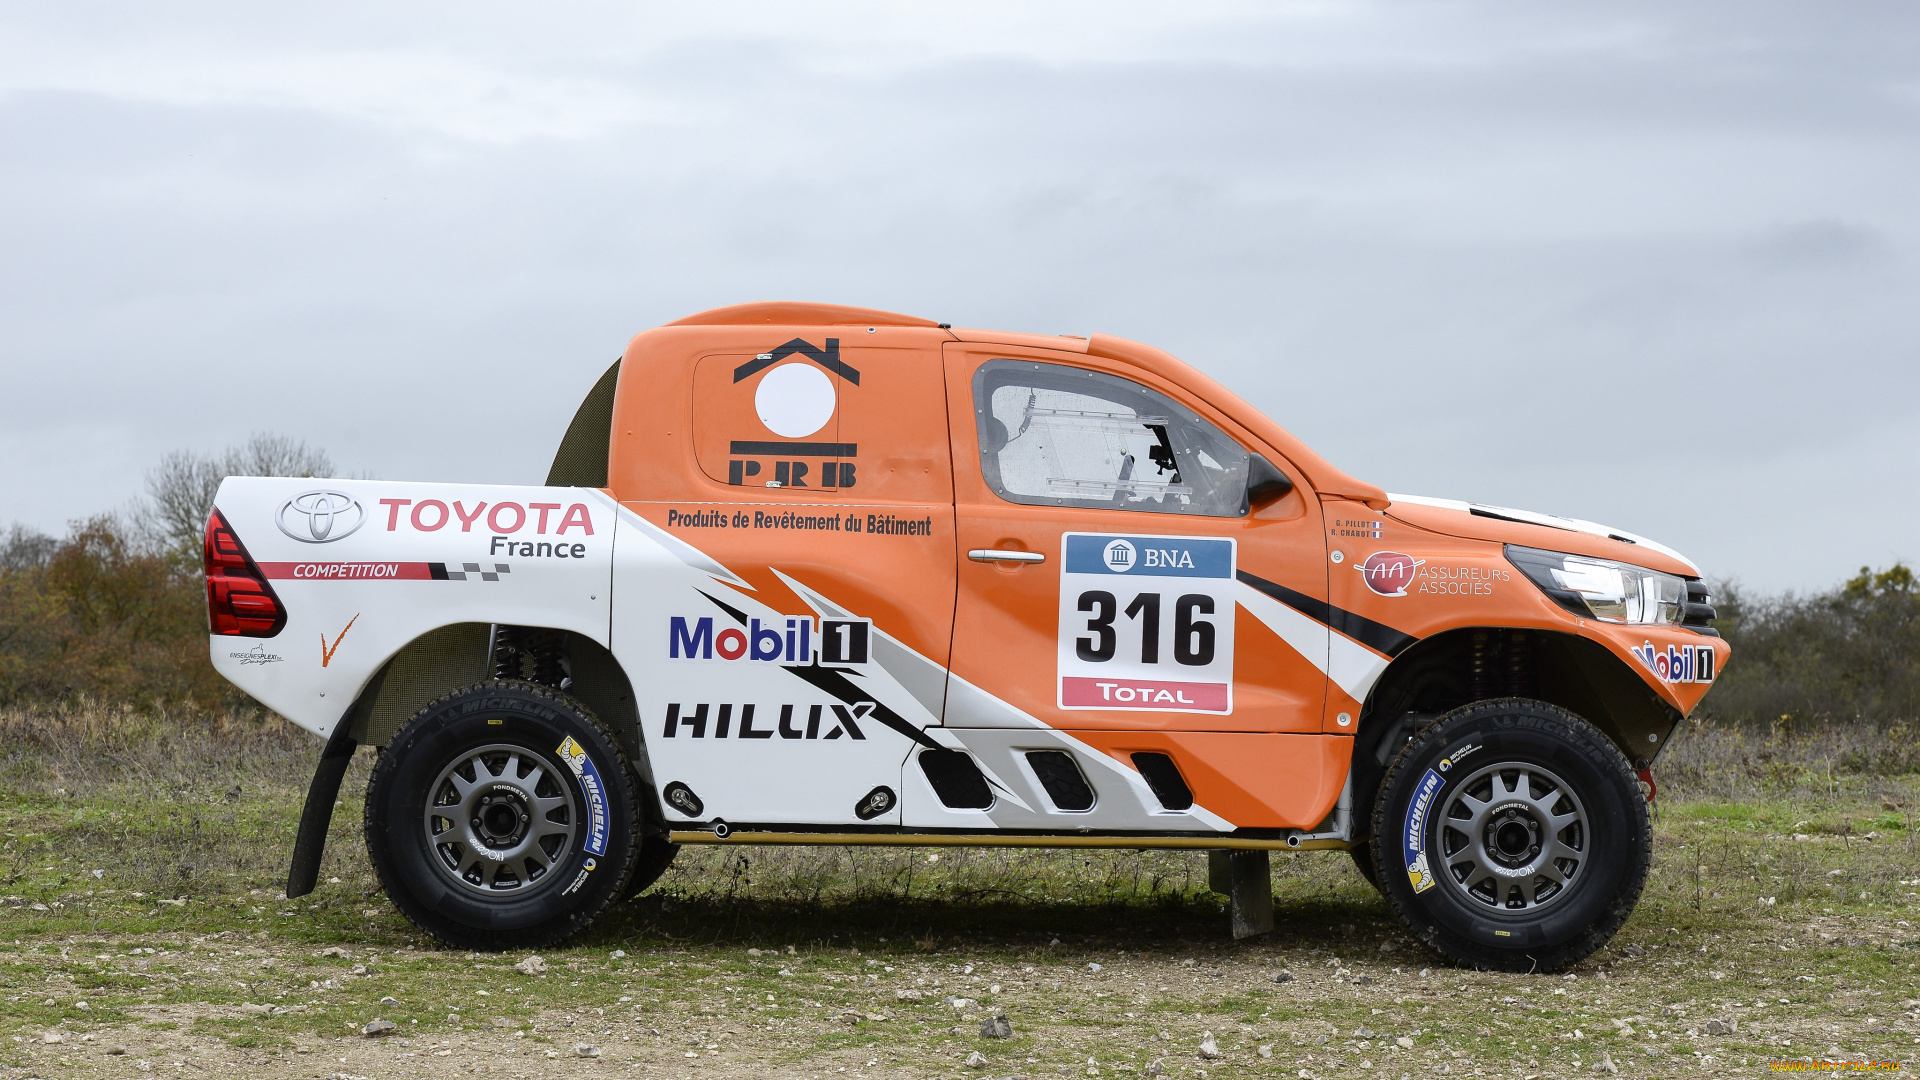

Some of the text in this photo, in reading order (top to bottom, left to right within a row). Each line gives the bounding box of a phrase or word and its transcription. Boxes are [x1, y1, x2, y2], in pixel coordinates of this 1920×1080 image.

[728, 459, 857, 488] PRB
[379, 498, 595, 536] TOYOTA
[667, 508, 932, 536] Produits de Revêtement du Bâtiment
[1345, 520, 1370, 528] PILLOT
[1340, 529, 1370, 538] CHABOT
[490, 536, 586, 558] France
[1144, 548, 1195, 568] BNA
[293, 561, 398, 578] COMPÉTITION
[1418, 566, 1511, 582] ASSUREURS
[1418, 579, 1493, 595] ASSOCIÉS
[669, 616, 811, 662] Mobil
[1076, 590, 1216, 666] 316
[1633, 647, 1694, 680] Mobil
[1095, 682, 1194, 704] TOTAL
[461, 698, 559, 720] MICHELIN
[662, 703, 874, 740] HILUX
[584, 774, 604, 852] MICHELIN
[1409, 774, 1438, 851] MICHELIN
